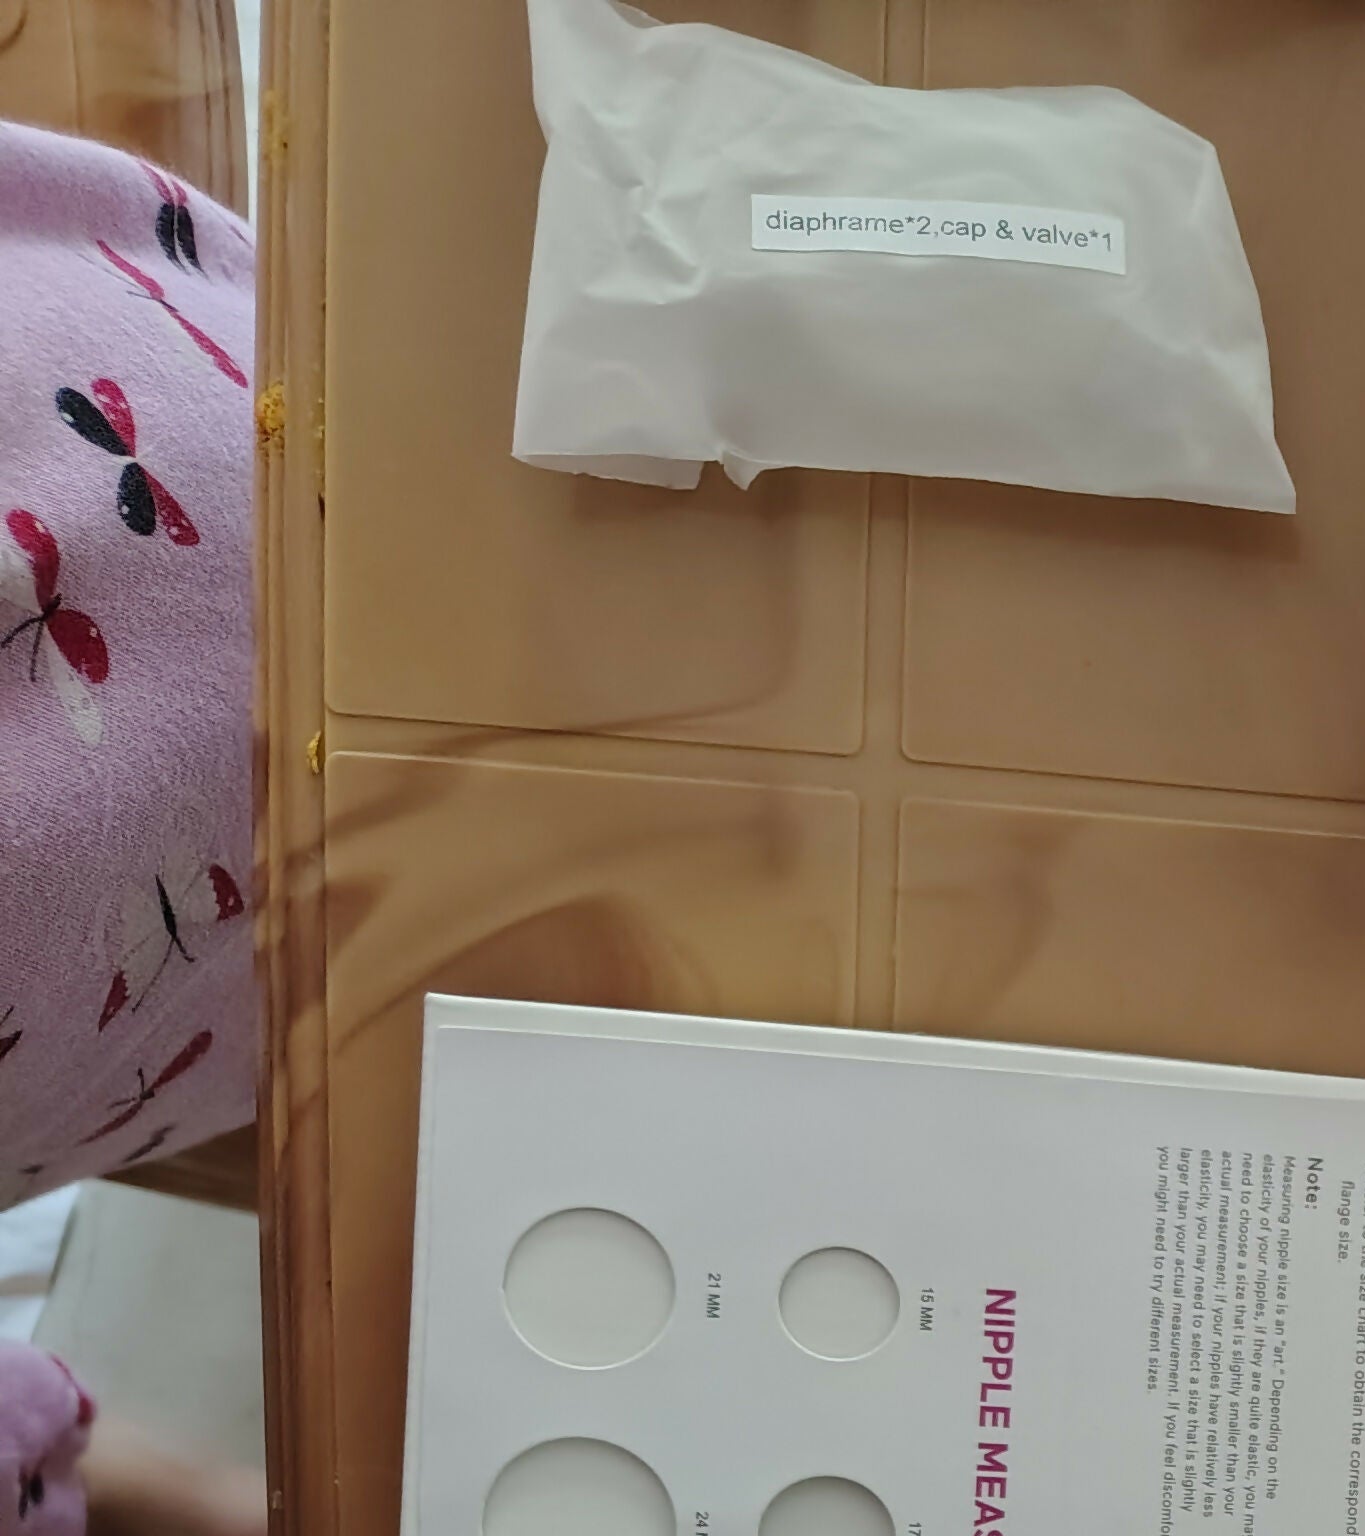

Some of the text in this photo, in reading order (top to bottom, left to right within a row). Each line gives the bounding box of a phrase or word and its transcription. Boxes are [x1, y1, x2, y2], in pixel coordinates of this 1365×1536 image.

[995, 218, 1014, 241] &
[705, 1272, 721, 1318] 21 MM
[919, 1287, 934, 1331] 15 MM
[978, 1288, 1016, 1428] NIPPLE
[695, 1511, 708, 1528] 24
[908, 1522, 922, 1536] 17
